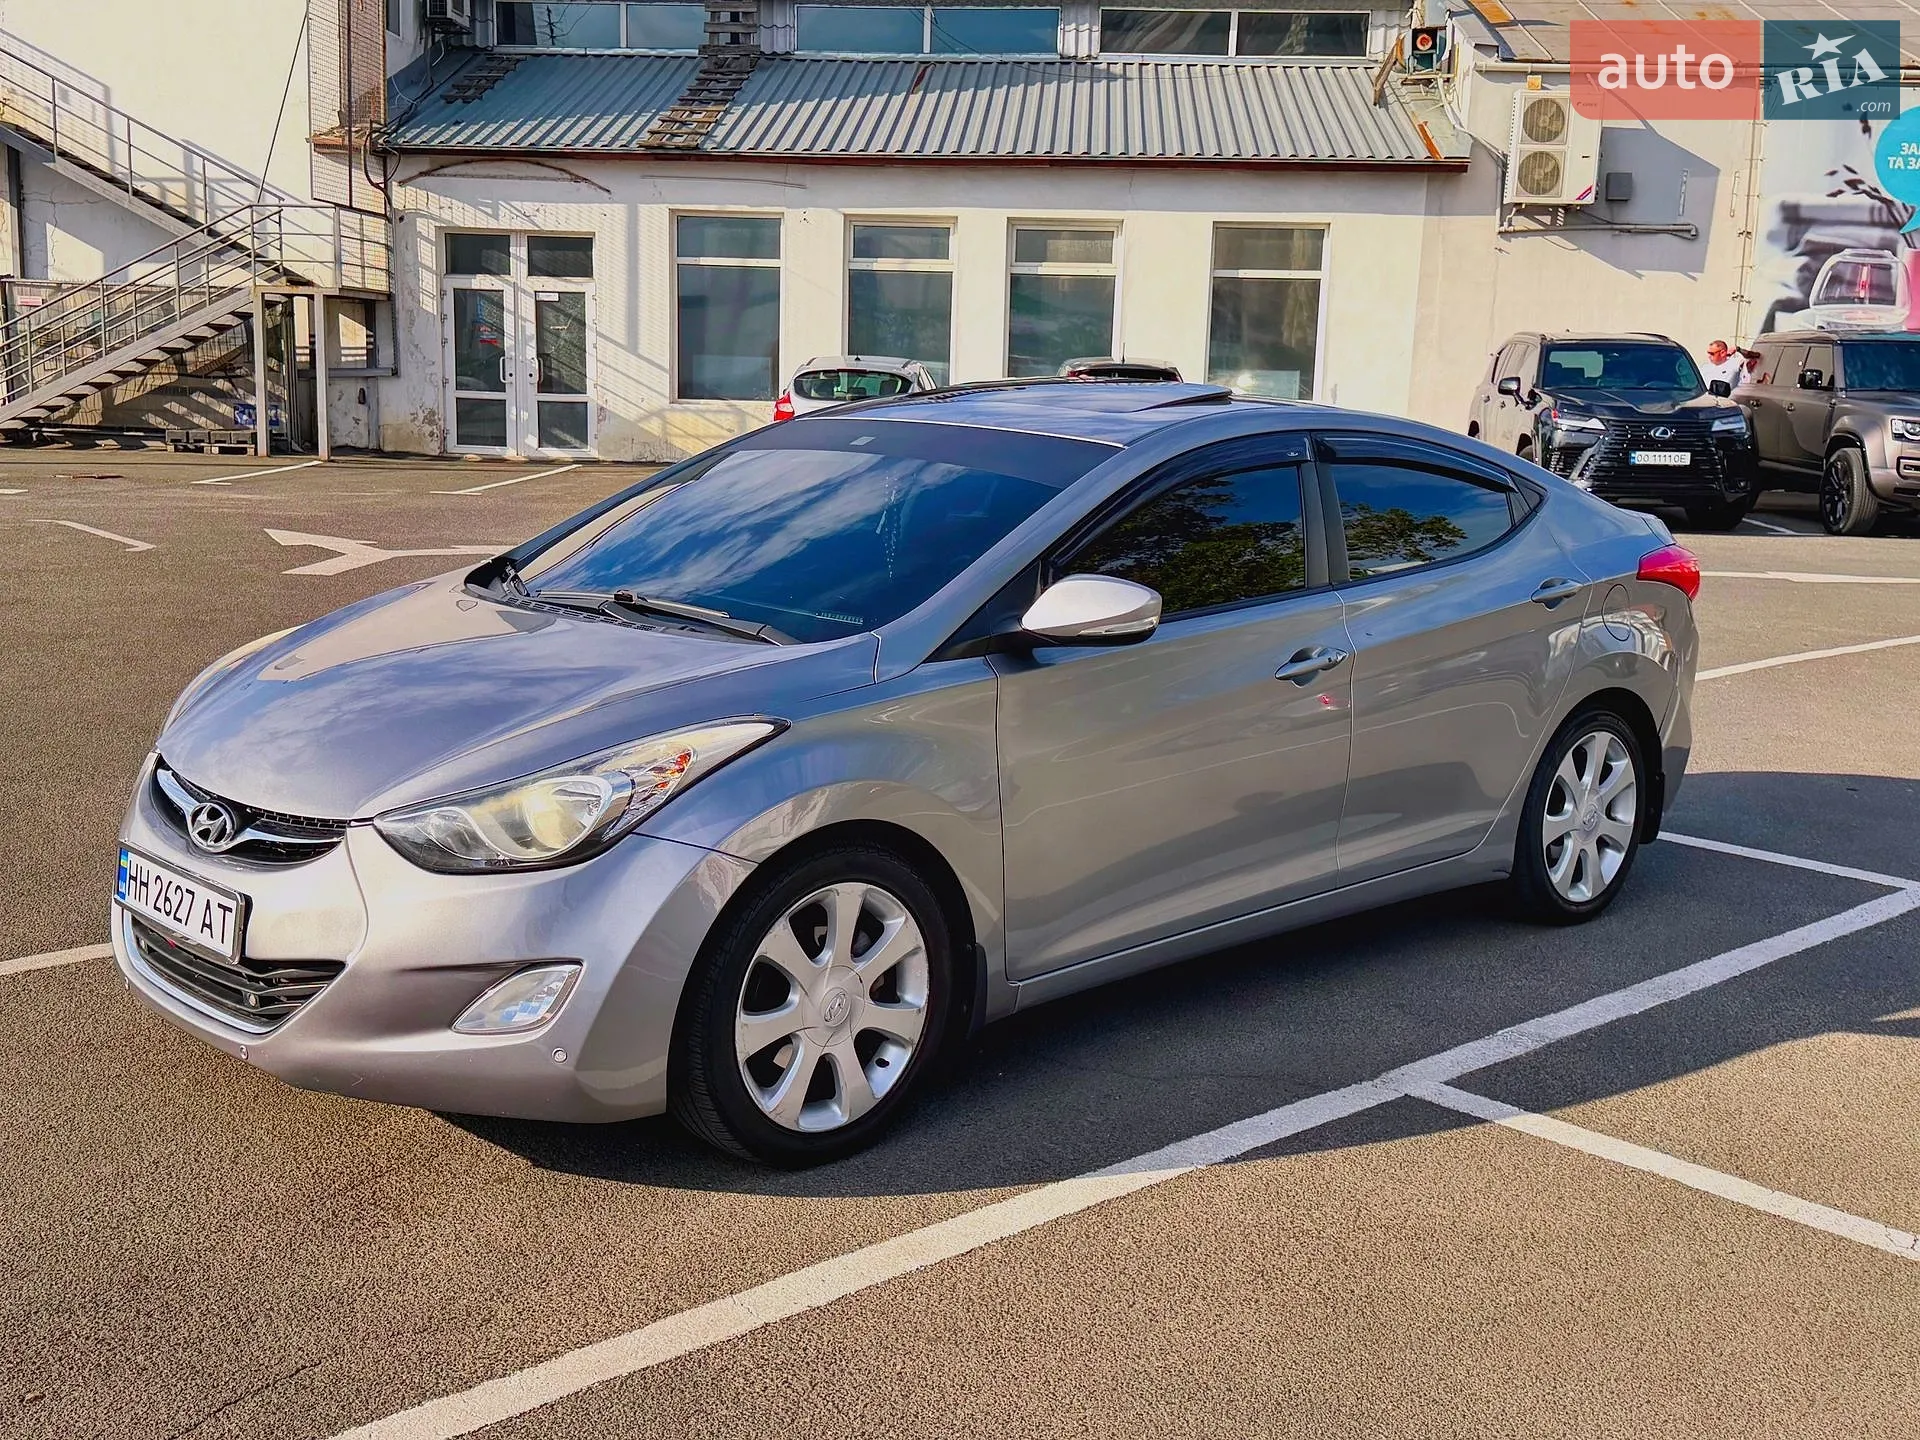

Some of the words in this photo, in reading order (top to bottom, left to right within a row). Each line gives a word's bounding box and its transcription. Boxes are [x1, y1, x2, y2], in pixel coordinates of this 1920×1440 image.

[1900, 142, 1920, 155] ЗА
[1888, 156, 1904, 169] ТА
[127, 859, 150, 906] HH
[153, 874, 195, 926] 2627
[200, 899, 233, 945] AT
